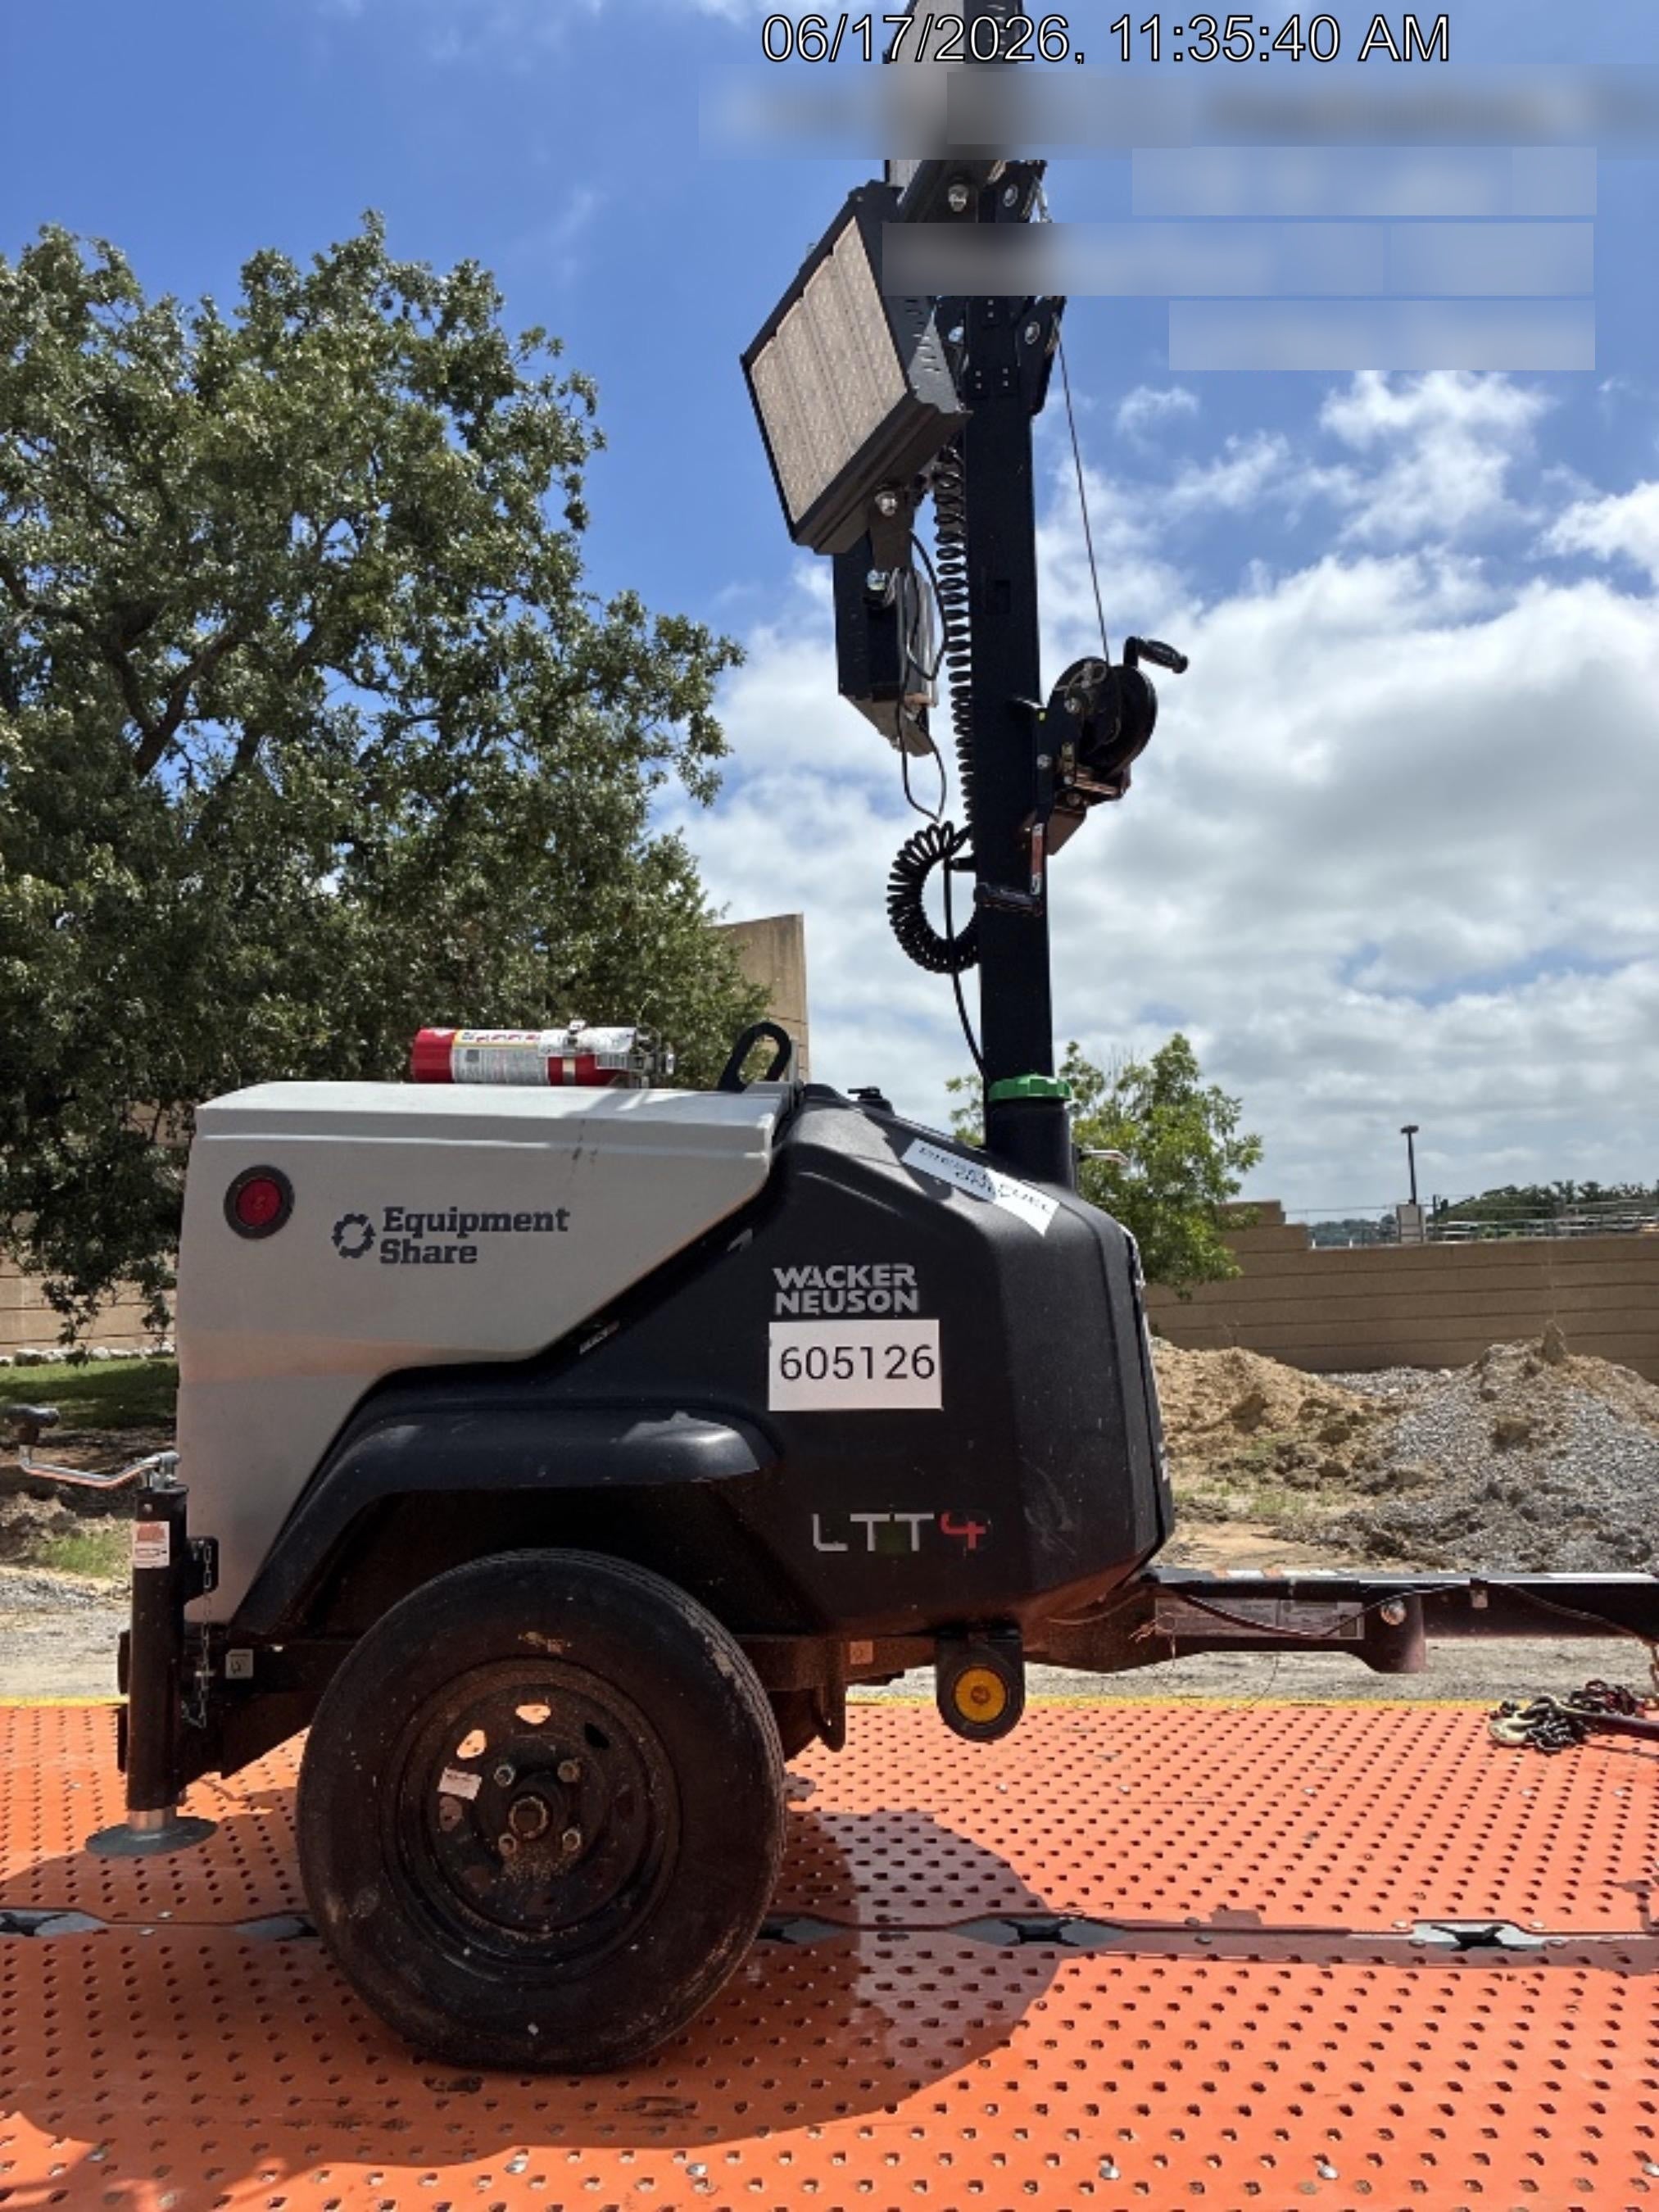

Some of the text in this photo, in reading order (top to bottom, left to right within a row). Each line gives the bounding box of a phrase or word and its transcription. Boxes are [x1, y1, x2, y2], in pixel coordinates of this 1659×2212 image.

[383, 1206, 571, 1239] Equipment
[379, 1239, 478, 1265] Share
[772, 1263, 918, 1290] WACKER
[774, 1290, 920, 1315] NEUSON
[780, 1344, 936, 1380] 605126
[811, 1512, 986, 1552] LTT4
